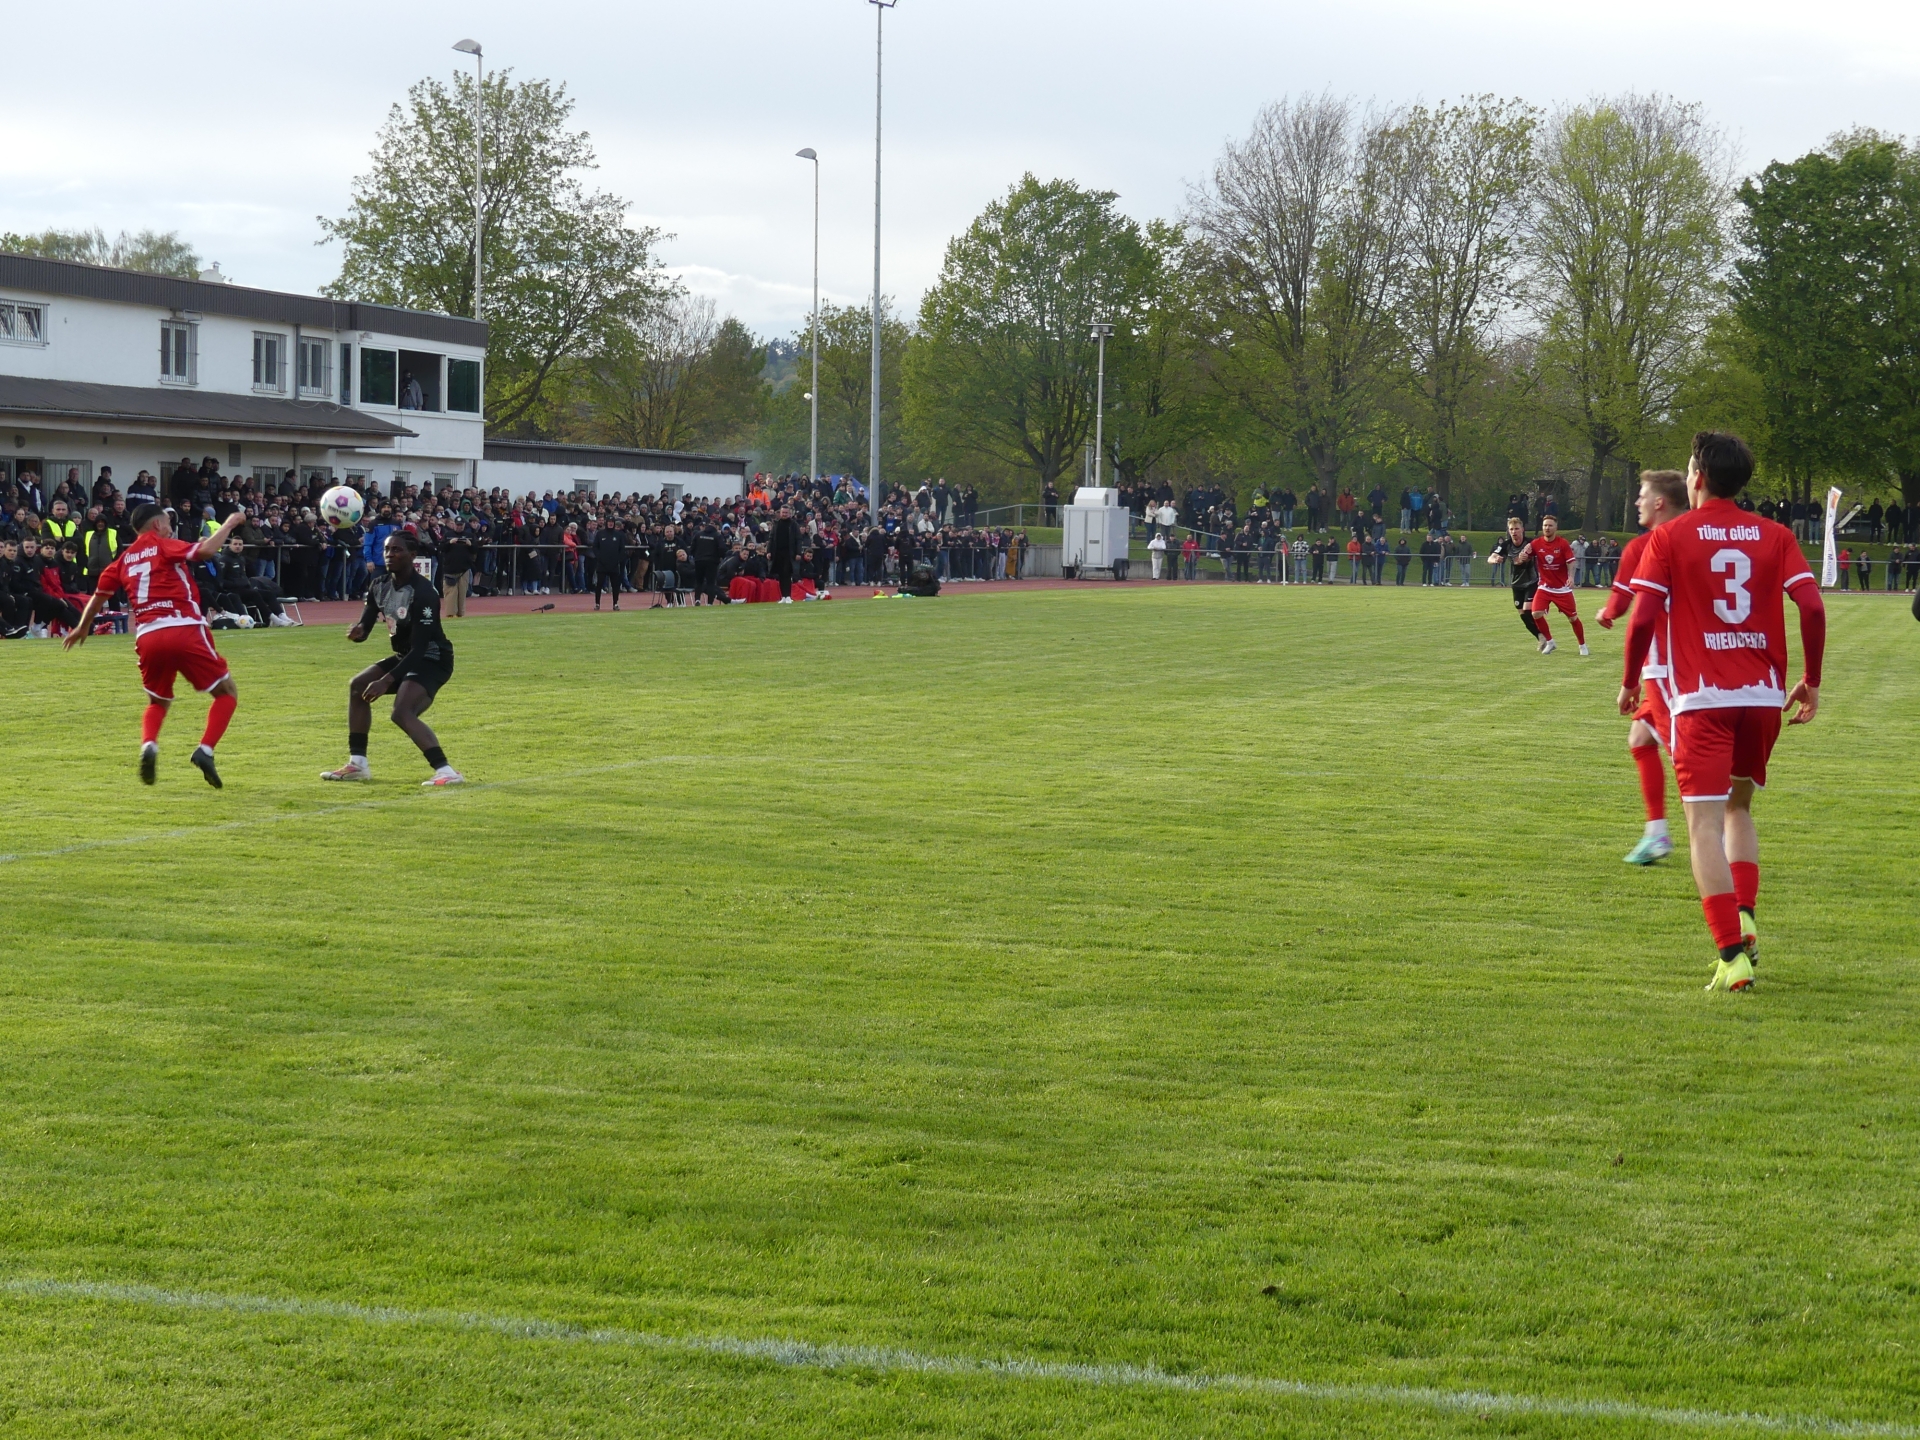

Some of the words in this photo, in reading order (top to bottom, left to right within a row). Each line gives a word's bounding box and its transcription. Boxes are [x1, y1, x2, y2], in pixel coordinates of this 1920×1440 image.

[1697, 525, 1727, 541] TÜRK
[1730, 525, 1760, 541] GÜCÜ
[128, 561, 151, 604] 7
[1711, 548, 1751, 624] 3
[1704, 631, 1767, 650] FRIEDBERG
